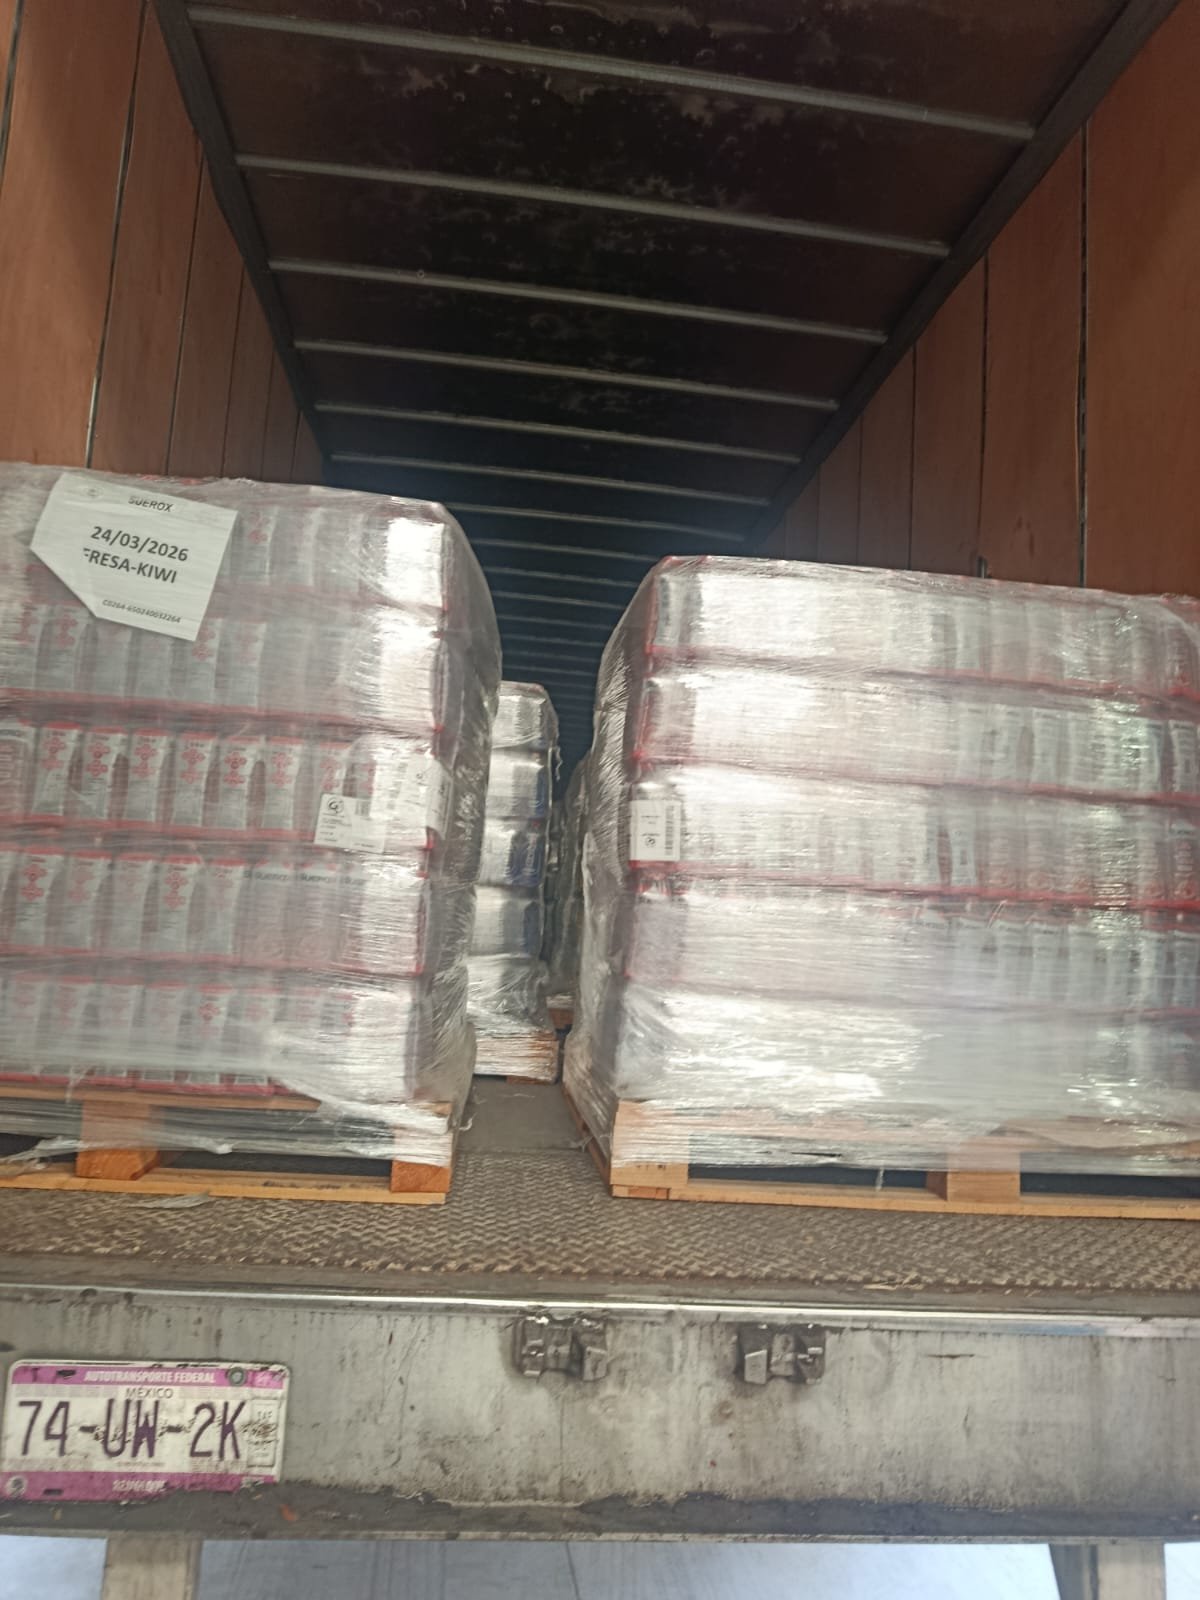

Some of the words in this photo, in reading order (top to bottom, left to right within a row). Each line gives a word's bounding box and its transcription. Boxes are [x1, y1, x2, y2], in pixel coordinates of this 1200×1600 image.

[128, 496, 173, 512] SUEROX
[91, 526, 189, 561] 24/03/2026
[84, 1370, 173, 1383] AUTOTRANSPORTE
[174, 1371, 216, 1384] FEDERAL
